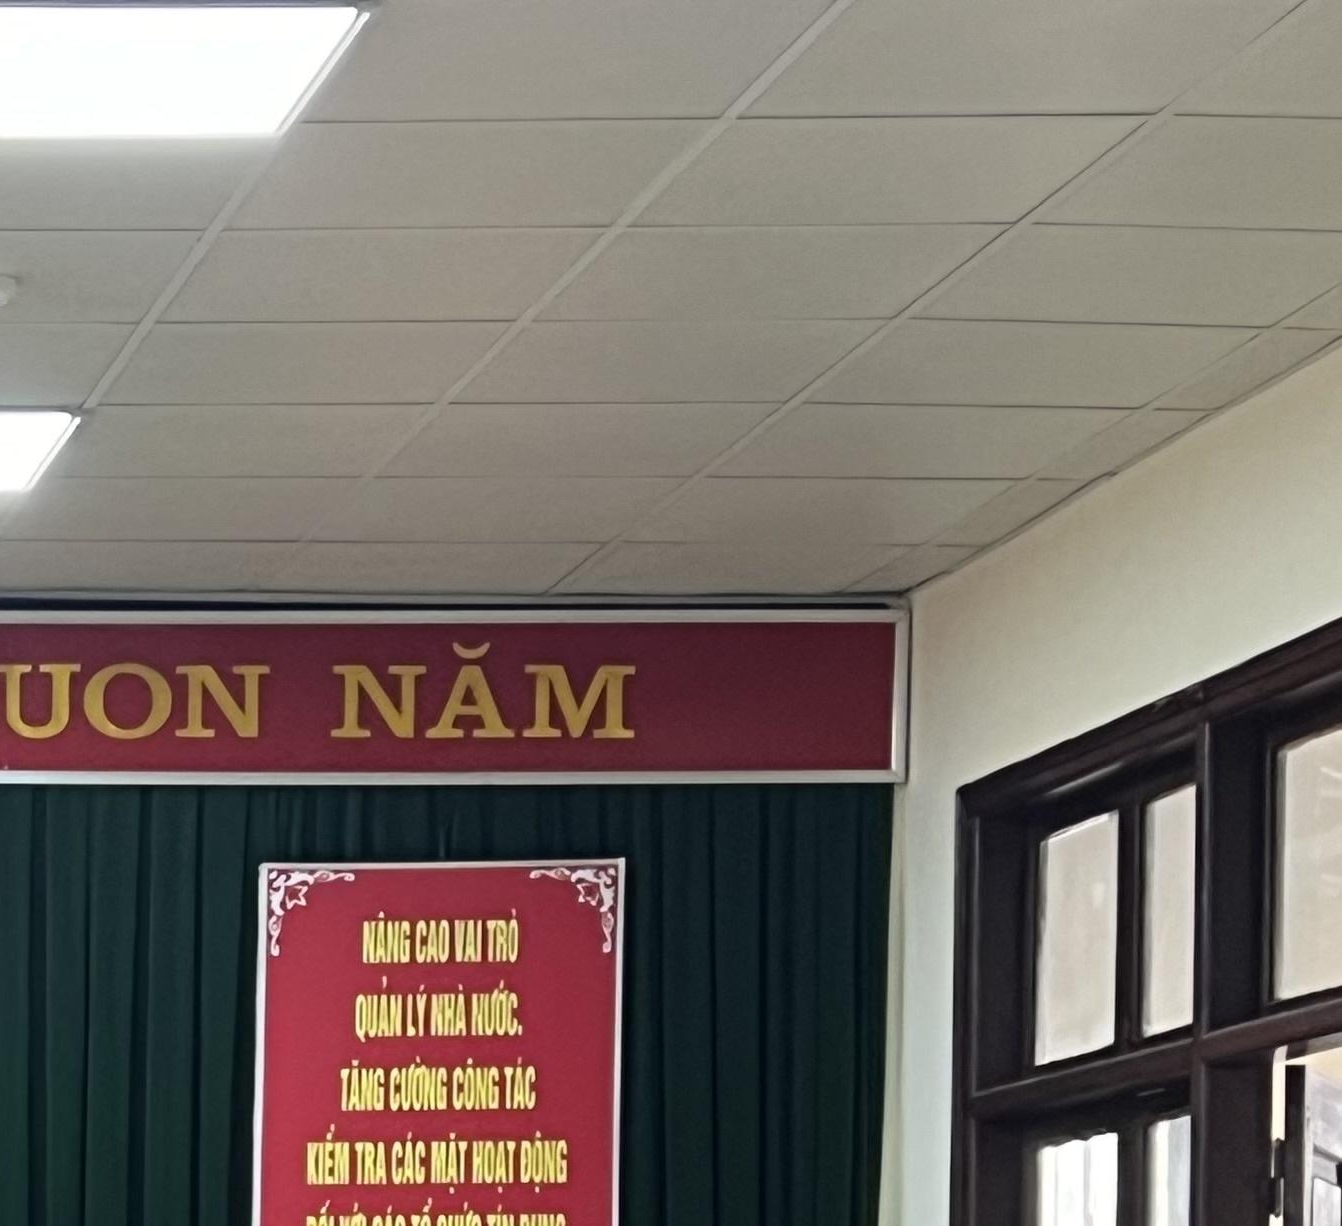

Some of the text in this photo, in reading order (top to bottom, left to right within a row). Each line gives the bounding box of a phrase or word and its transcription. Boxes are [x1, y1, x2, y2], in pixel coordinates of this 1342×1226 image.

[331, 640, 636, 740] NĂM
[362, 911, 410, 963] NÂNG
[415, 919, 450, 962] CAO
[454, 919, 483, 962] VAI
[355, 975, 402, 1042] QUẢN
[406, 984, 426, 1036] LÝ
[430, 984, 466, 1036] NHÀ
[340, 1056, 536, 1111] TĂNG CƯỜNG CÔNG TÁC
[355, 1142, 387, 1184] TRA
[392, 1131, 425, 1184] CÁC
[431, 1132, 467, 1194] MẶT
[472, 1141, 515, 1193] HOẠT
[520, 1131, 567, 1193] ĐỘNG
